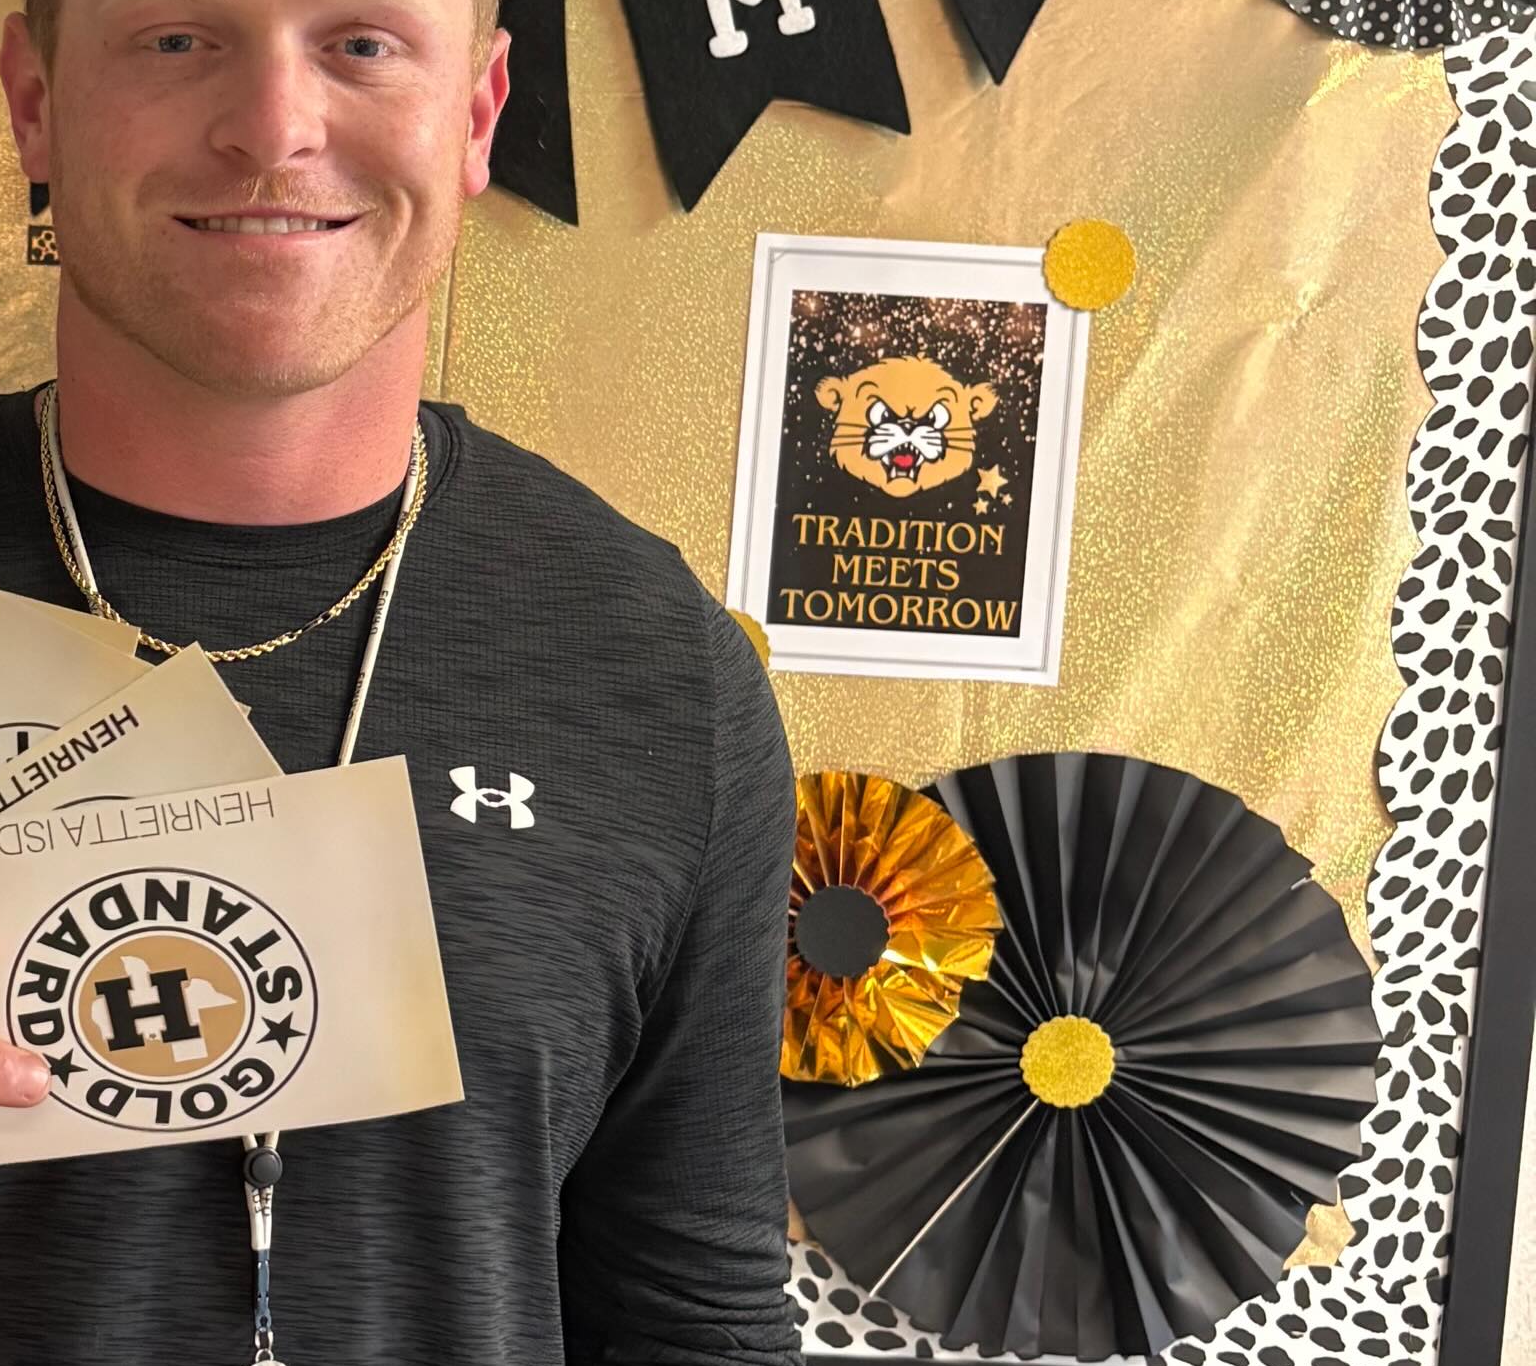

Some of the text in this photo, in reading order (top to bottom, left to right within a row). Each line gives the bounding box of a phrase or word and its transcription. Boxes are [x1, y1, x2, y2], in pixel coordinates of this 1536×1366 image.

[792, 513, 1005, 556] TRADITION
[831, 554, 960, 591] MEETS
[779, 588, 1017, 632] TOMORROW
[60, 787, 275, 848] HENRIETTA
[17, 878, 303, 1047] STANDARD
[85, 1057, 276, 1125] GOLD
